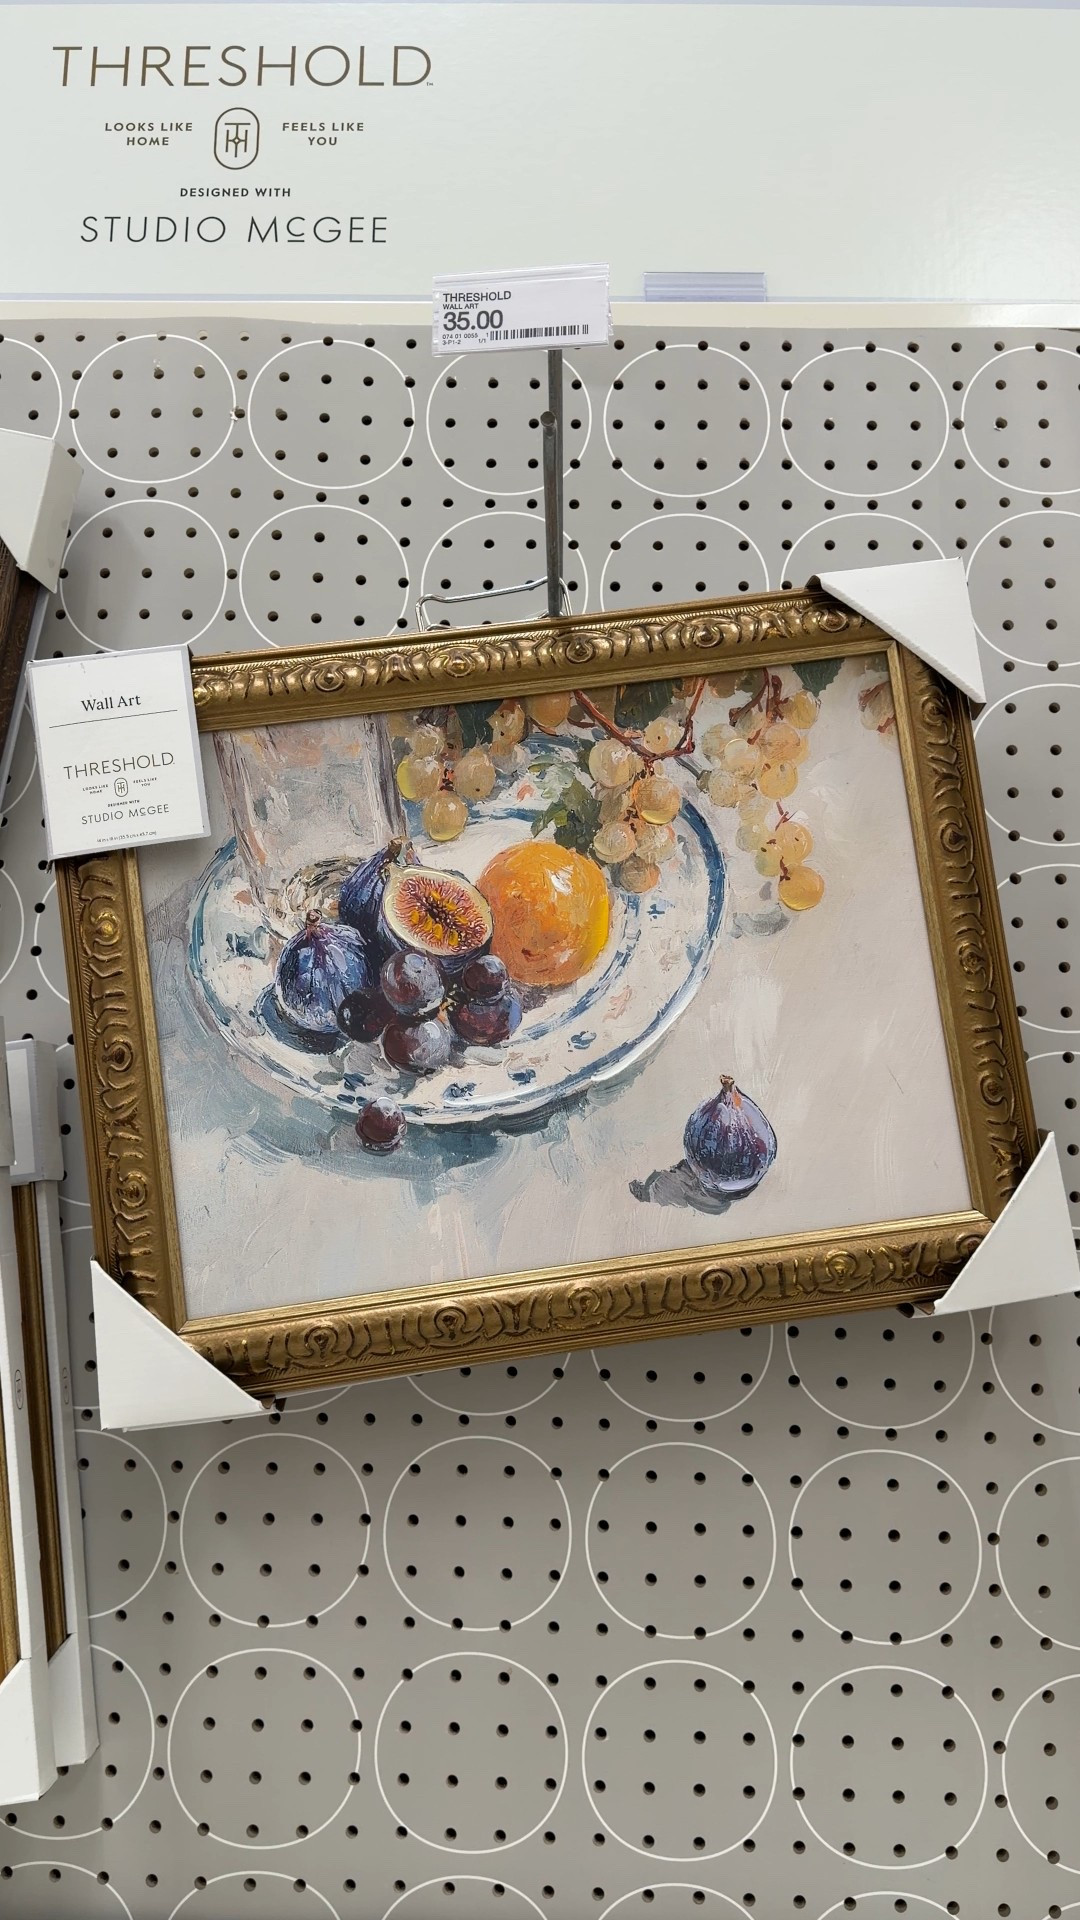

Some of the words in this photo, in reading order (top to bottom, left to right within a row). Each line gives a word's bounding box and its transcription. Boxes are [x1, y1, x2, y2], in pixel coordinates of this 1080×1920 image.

[53, 45, 431, 87] THRESHOLD
[105, 122, 154, 132] LOOKS
[161, 122, 193, 132] LIKE
[282, 122, 326, 132] FEELS
[332, 122, 364, 132] LIKE
[126, 137, 170, 147] HOME
[307, 137, 338, 146] YOU
[180, 188, 249, 198] DESIGNED
[255, 188, 291, 198] WITH
[80, 216, 226, 243] STUDIO
[443, 291, 511, 302] THRESHOLD
[443, 310, 503, 331] 35.00
[81, 697, 113, 711] Wall
[117, 695, 141, 708] Art
[63, 752, 174, 780] THRESHOLD
[81, 810, 124, 824] STUDIO
